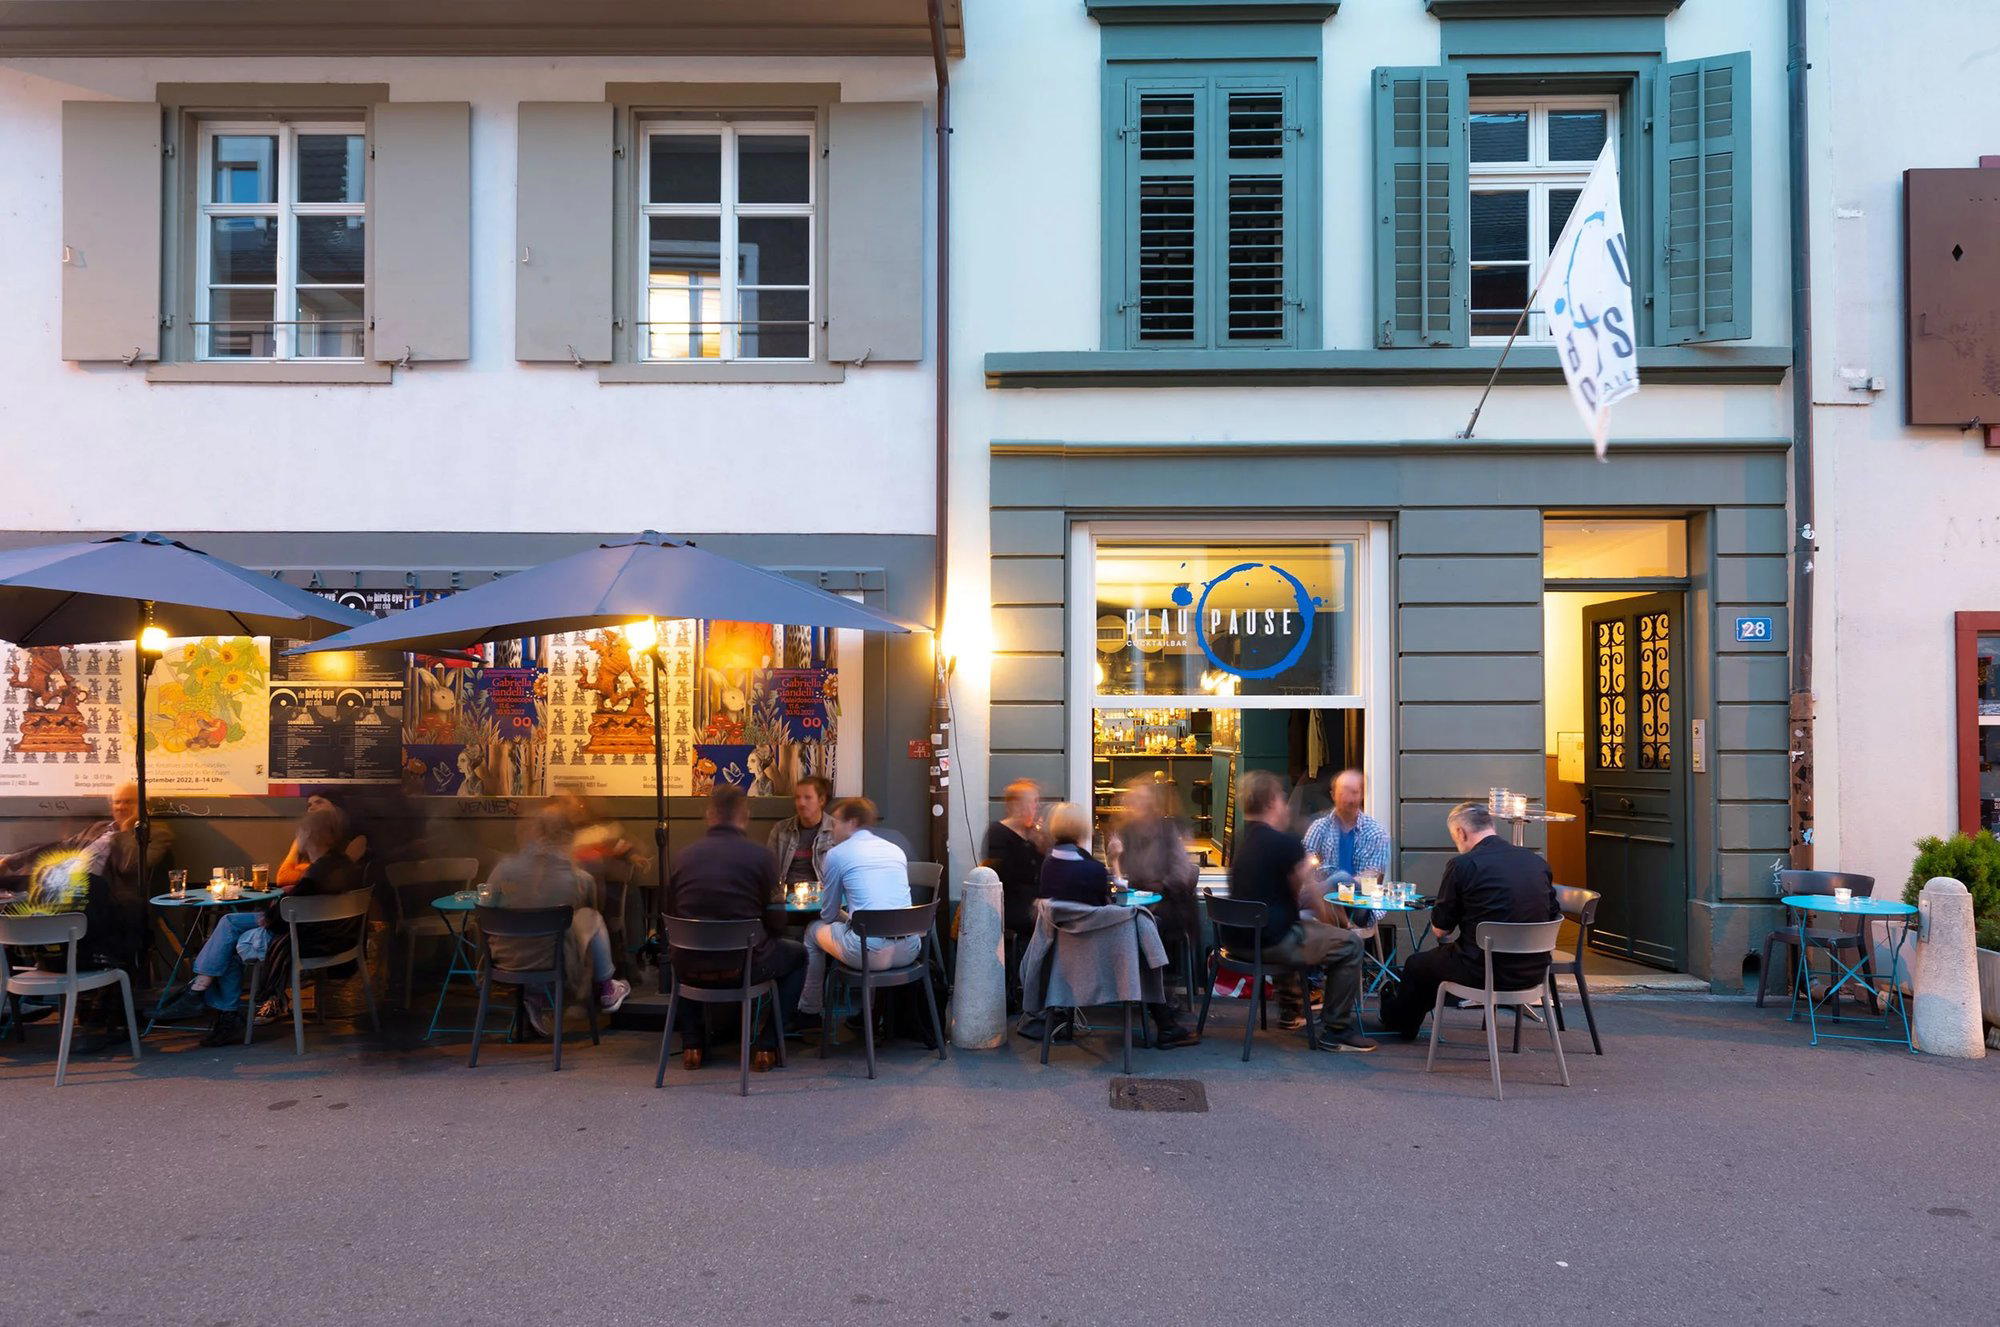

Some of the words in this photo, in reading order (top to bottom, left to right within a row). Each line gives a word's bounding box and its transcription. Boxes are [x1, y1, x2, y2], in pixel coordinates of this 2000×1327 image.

[1126, 608, 1188, 635] BLAU
[1211, 608, 1292, 635] PAUSE
[1741, 621, 1766, 637] 28
